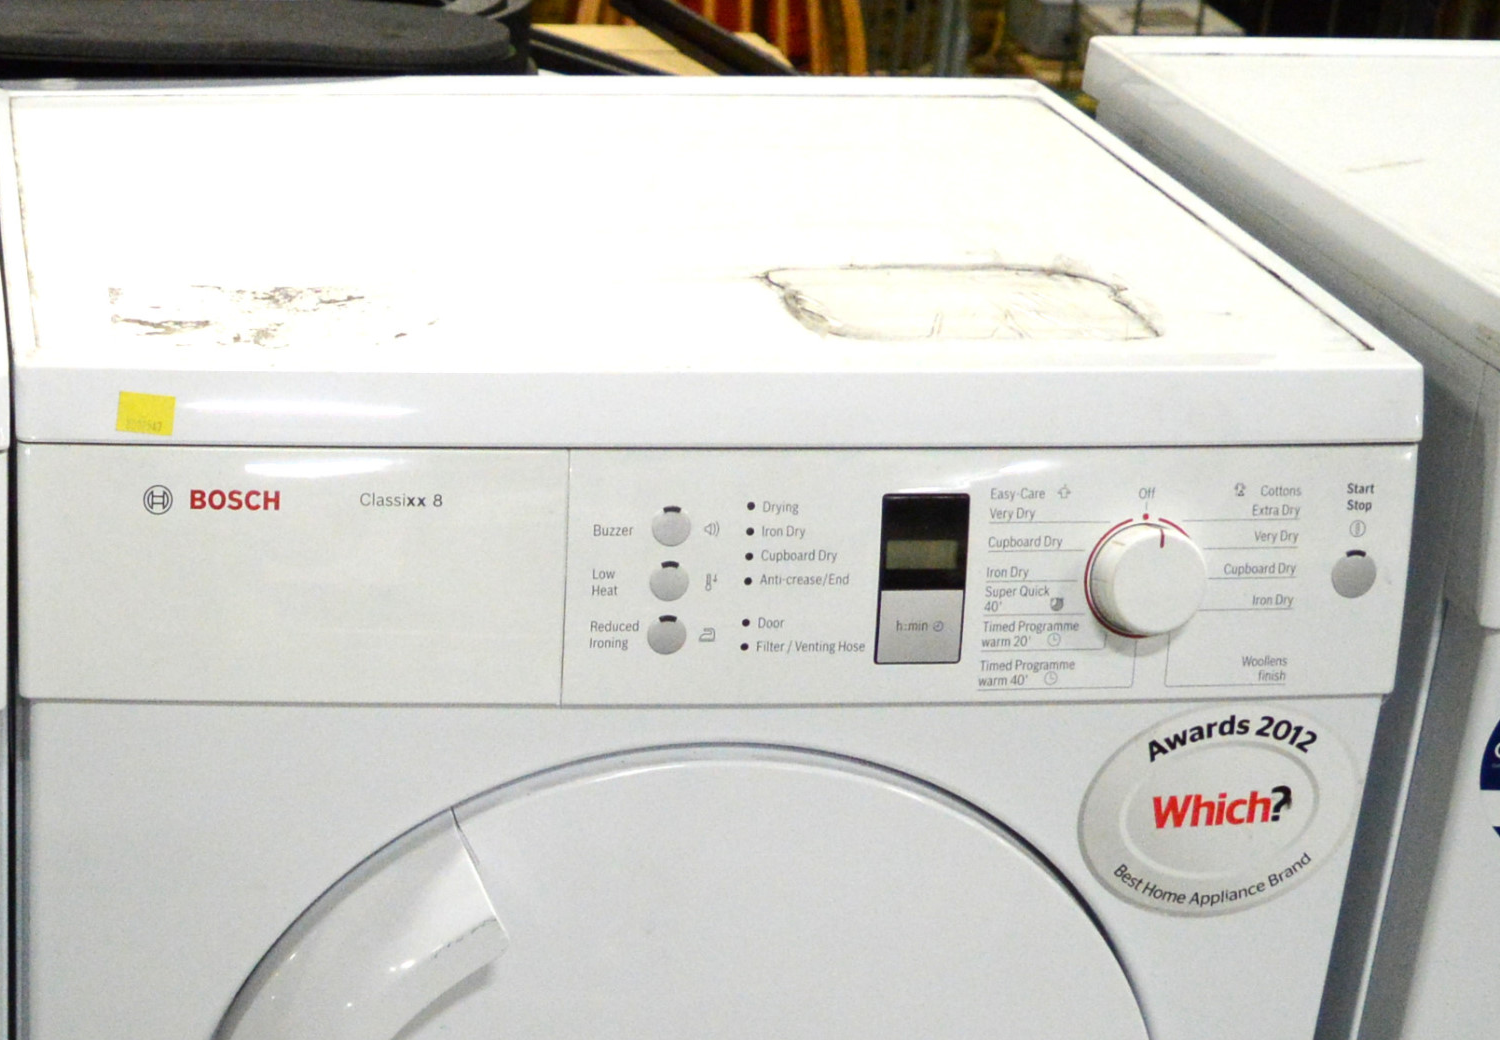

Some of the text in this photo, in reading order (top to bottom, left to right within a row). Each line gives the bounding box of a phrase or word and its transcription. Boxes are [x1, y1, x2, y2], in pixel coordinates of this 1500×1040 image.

[1139, 488, 1156, 499] Off
[1260, 485, 1302, 497] Cottons
[1347, 483, 1374, 494] Start
[189, 489, 280, 511] BOSCH
[359, 493, 442, 507] Classixx 8
[1347, 500, 1372, 512] Stop
[763, 501, 799, 515] Drying
[990, 507, 1036, 520] Very Dry
[1252, 504, 1300, 516] Extra Dry
[593, 525, 633, 536] Buzzer
[762, 526, 805, 539] Iron Dry
[1255, 530, 1299, 543] Very Dry
[988, 536, 1063, 549] Cupboard Dry
[761, 550, 837, 563] Cupboard Dry
[592, 569, 615, 580] Low
[987, 567, 1029, 578] Iron Dry
[1224, 563, 1296, 576] Cupboard Dry
[759, 573, 849, 587] Anti-crease/End
[592, 585, 618, 596] Heat
[985, 585, 1049, 597] Super Quick
[1252, 595, 1294, 606] Iron Dry
[590, 621, 639, 632] Reduced
[758, 617, 785, 628] Door
[896, 621, 928, 632] h:min
[984, 621, 1079, 632] Timed Programme
[589, 638, 629, 650] Ironing
[756, 641, 785, 652] Filter
[795, 641, 835, 653] Venting
[838, 641, 865, 652] Hose
[982, 637, 1011, 647] warm
[980, 660, 1075, 672] Timed Programme
[1242, 656, 1288, 667] Woollens
[978, 676, 1008, 686] warm
[1258, 670, 1286, 681] finish
[1148, 715, 1317, 762] Awards 2012
[1153, 785, 1292, 829] Which?
[1114, 852, 1311, 907] Best Home Appliance Brand
